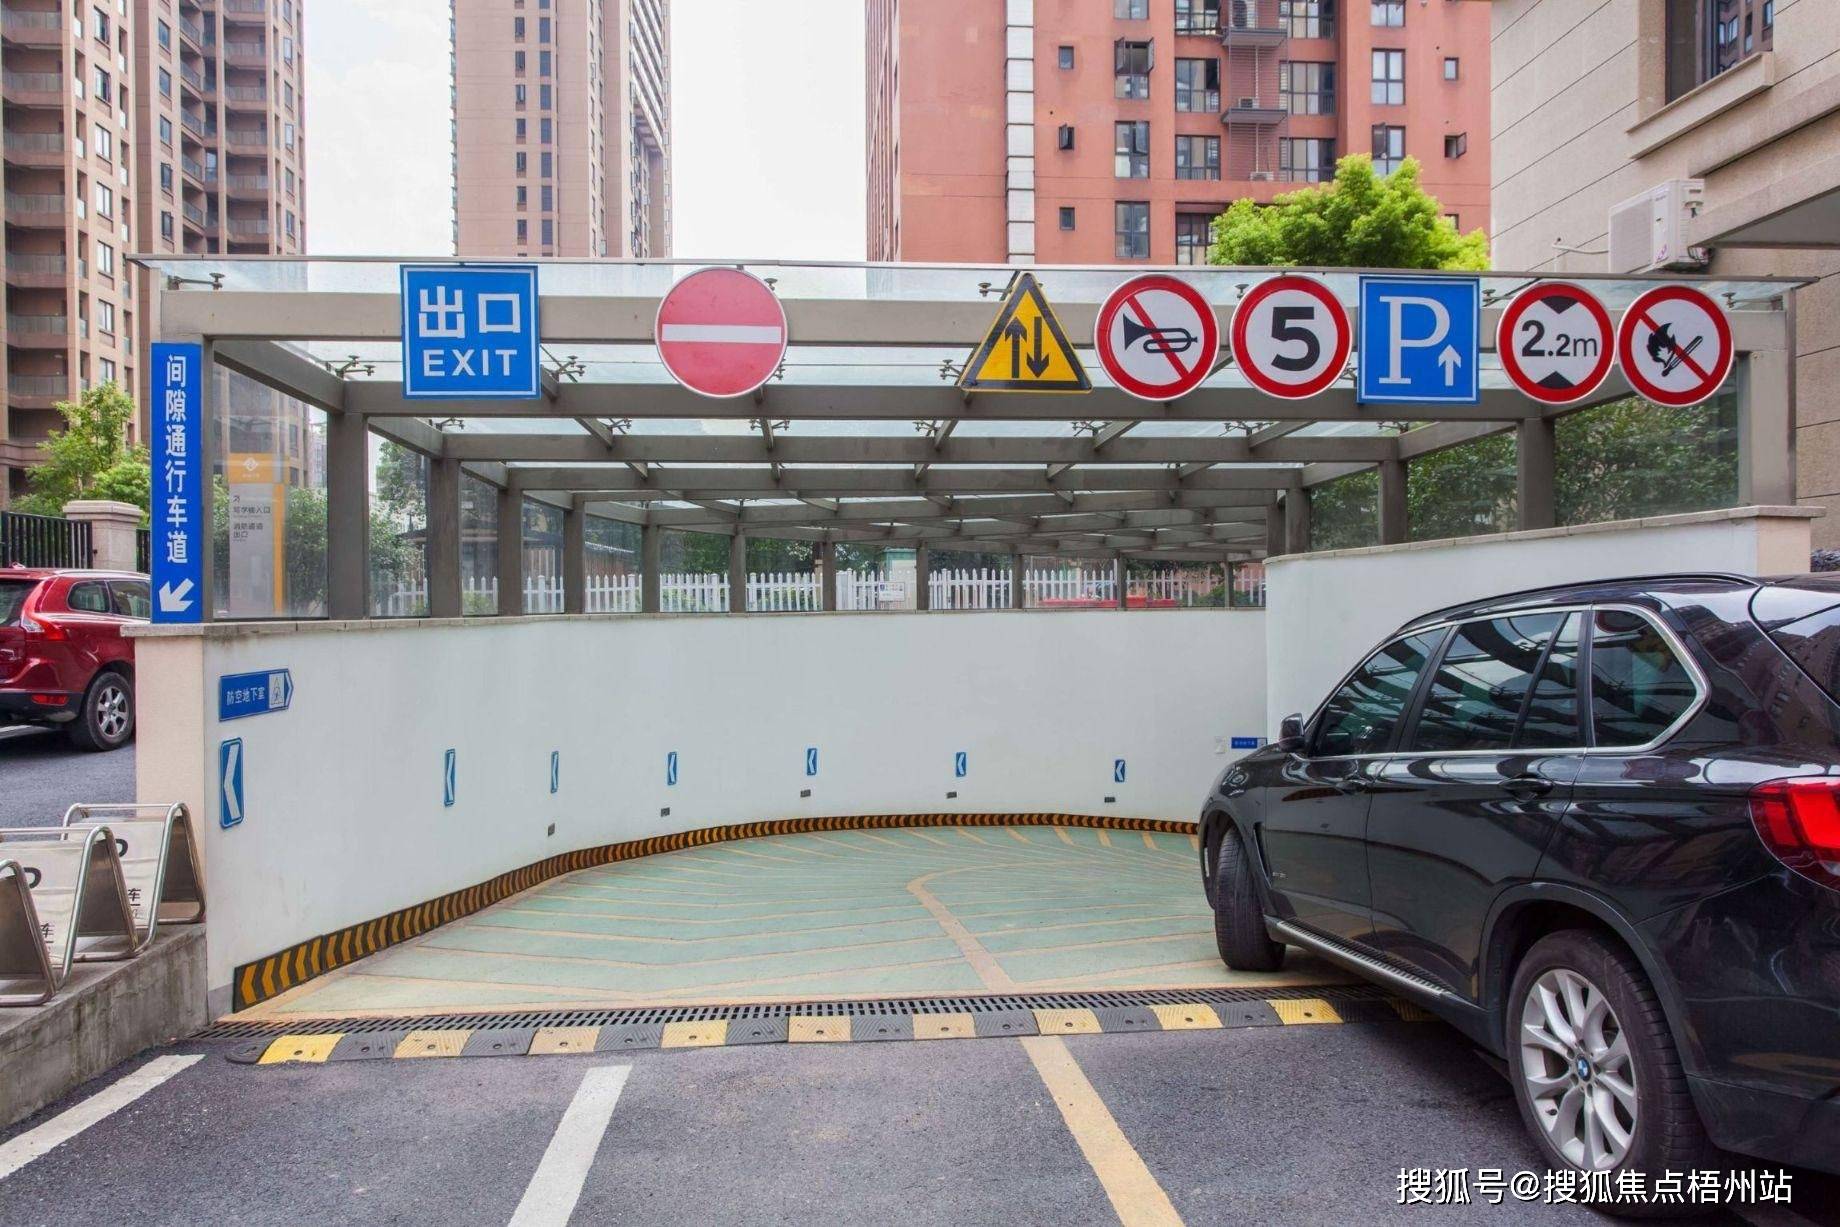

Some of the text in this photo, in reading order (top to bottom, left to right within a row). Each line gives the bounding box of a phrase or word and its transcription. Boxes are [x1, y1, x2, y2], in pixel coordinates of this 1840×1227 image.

[419, 286, 520, 338] 出口
[423, 349, 517, 377] EXIT
[1271, 307, 1320, 371] 5
[1379, 296, 1451, 384] P
[1521, 320, 1598, 357] 2.2m
[165, 355, 189, 564] 间隙通行车道
[226, 686, 265, 706] 防空地下室
